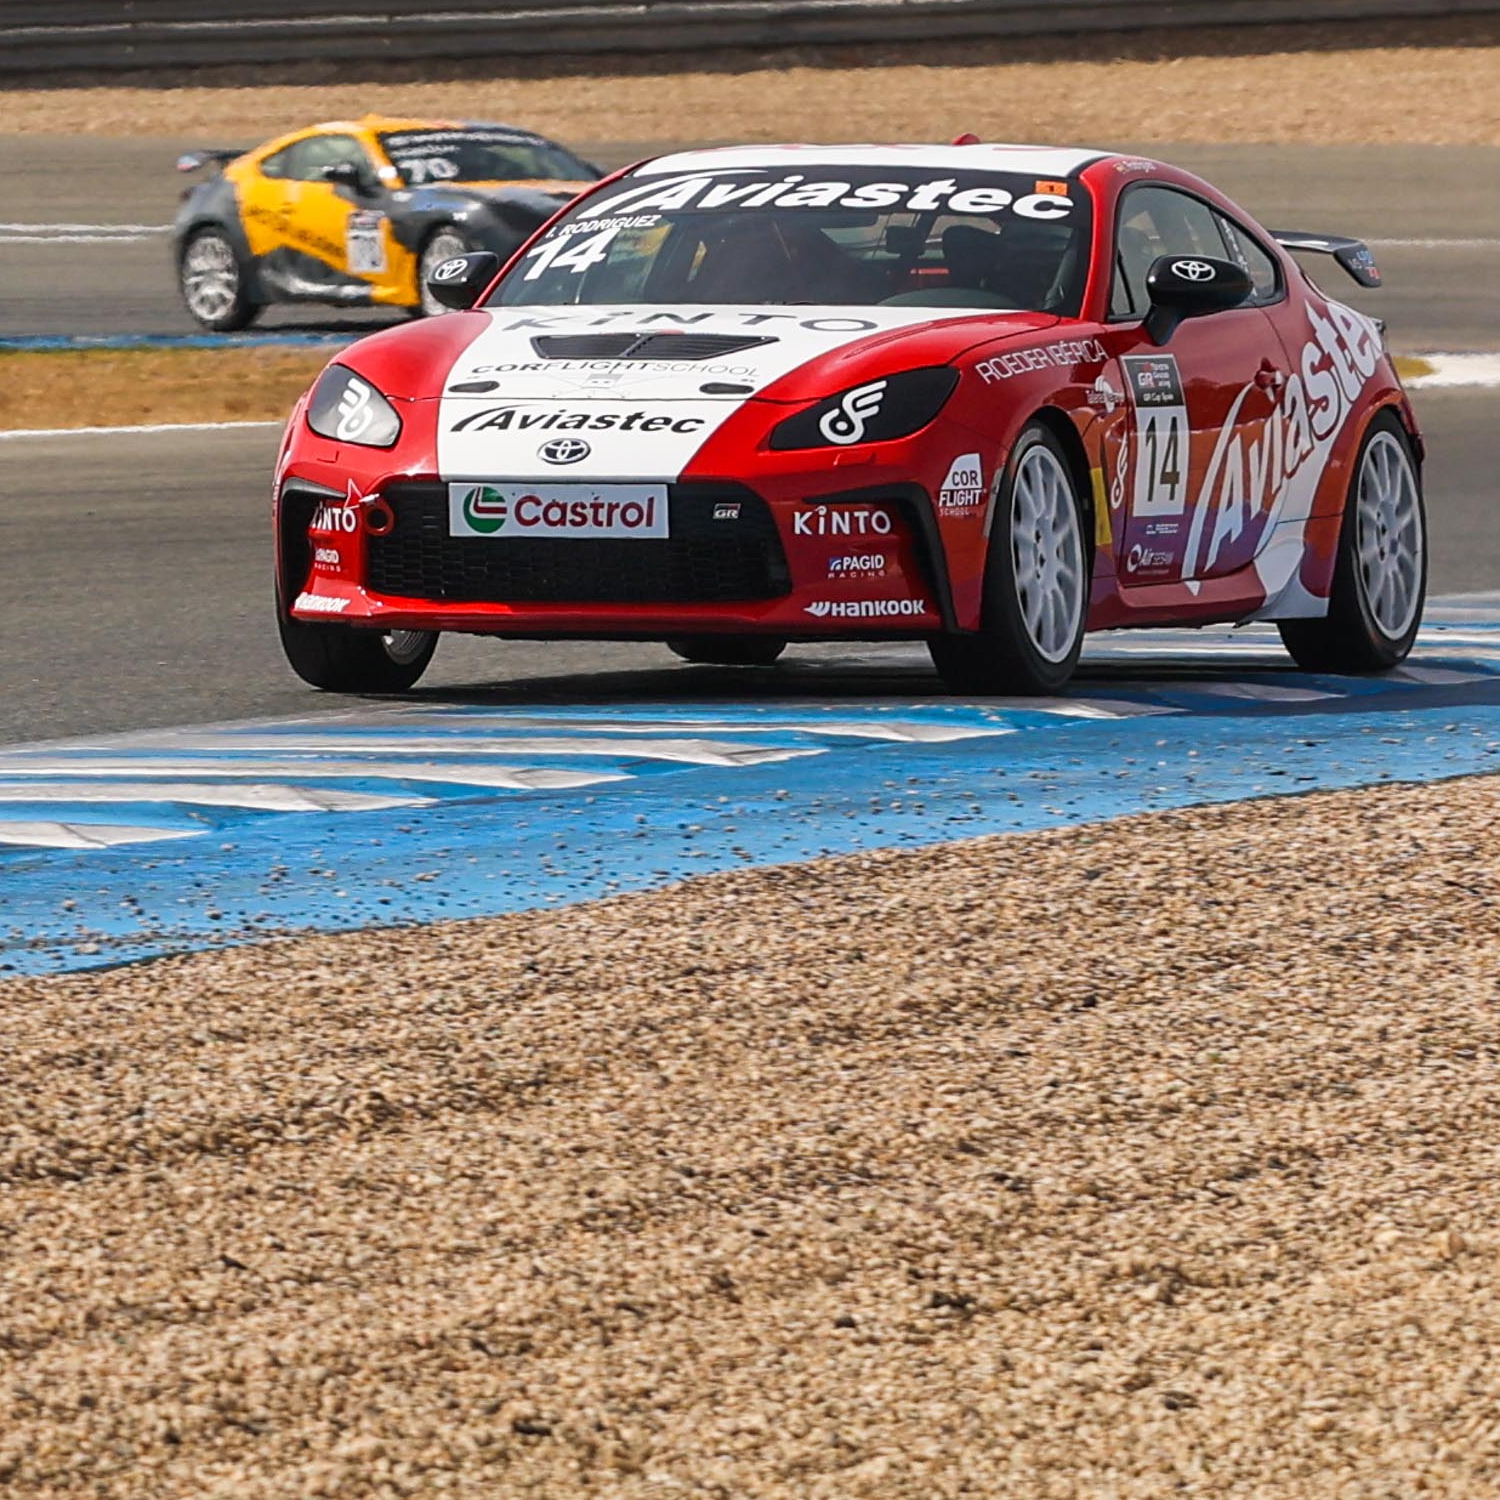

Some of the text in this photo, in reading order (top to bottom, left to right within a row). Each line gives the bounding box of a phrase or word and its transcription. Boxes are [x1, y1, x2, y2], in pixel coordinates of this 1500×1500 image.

[398, 157, 460, 183] 70
[577, 169, 1076, 221] Aviastec
[558, 214, 663, 238] RODRIGUEZ
[523, 227, 621, 282] 14
[975, 347, 1056, 385] ROEDER
[450, 403, 706, 434] Aviastec
[1145, 415, 1181, 503] 14
[951, 470, 979, 487] COR
[938, 489, 983, 508] FLIGHT
[515, 493, 656, 532] Castrol
[714, 508, 739, 519] GR
[827, 570, 886, 579] RACING
[842, 554, 885, 571] PAGID
